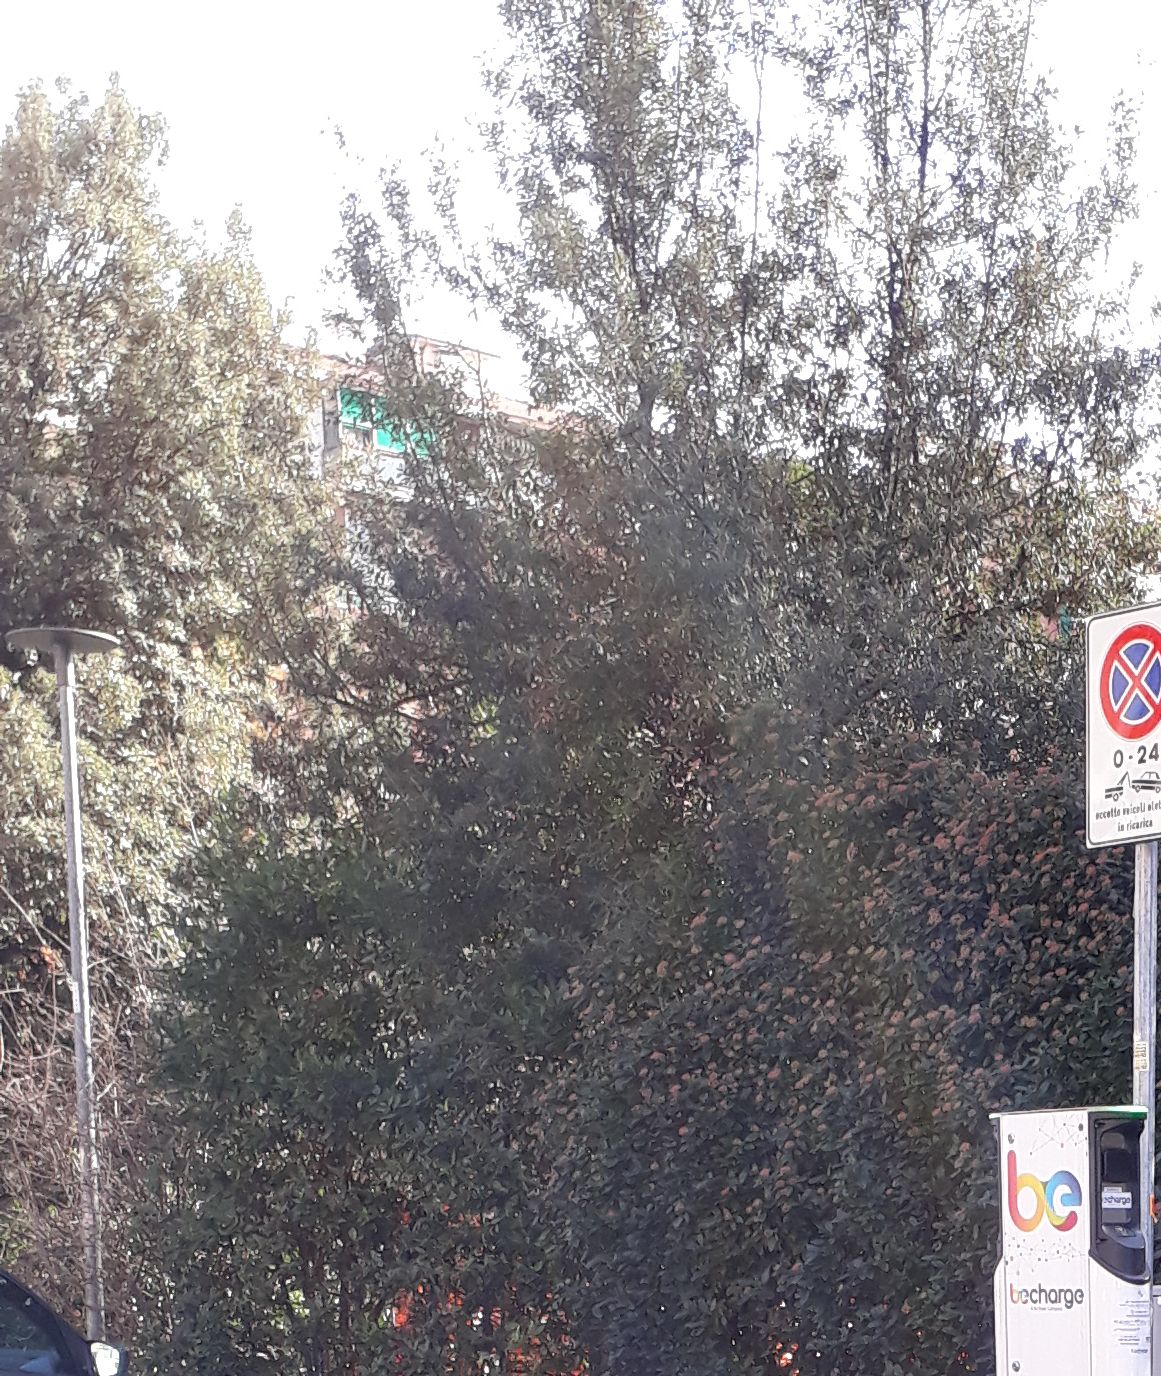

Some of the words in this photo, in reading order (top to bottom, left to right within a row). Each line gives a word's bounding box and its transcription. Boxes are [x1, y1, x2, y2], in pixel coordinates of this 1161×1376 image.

[1113, 749, 1124, 769] 0
[1137, 742, 1160, 765] 24
[1095, 806, 1121, 820] eccetto
[1122, 802, 1146, 816] veicoli
[1117, 821, 1125, 832] in
[1126, 817, 1153, 831] ricarica
[1007, 1149, 1083, 1233] be
[1009, 1282, 1085, 1310] becharge
